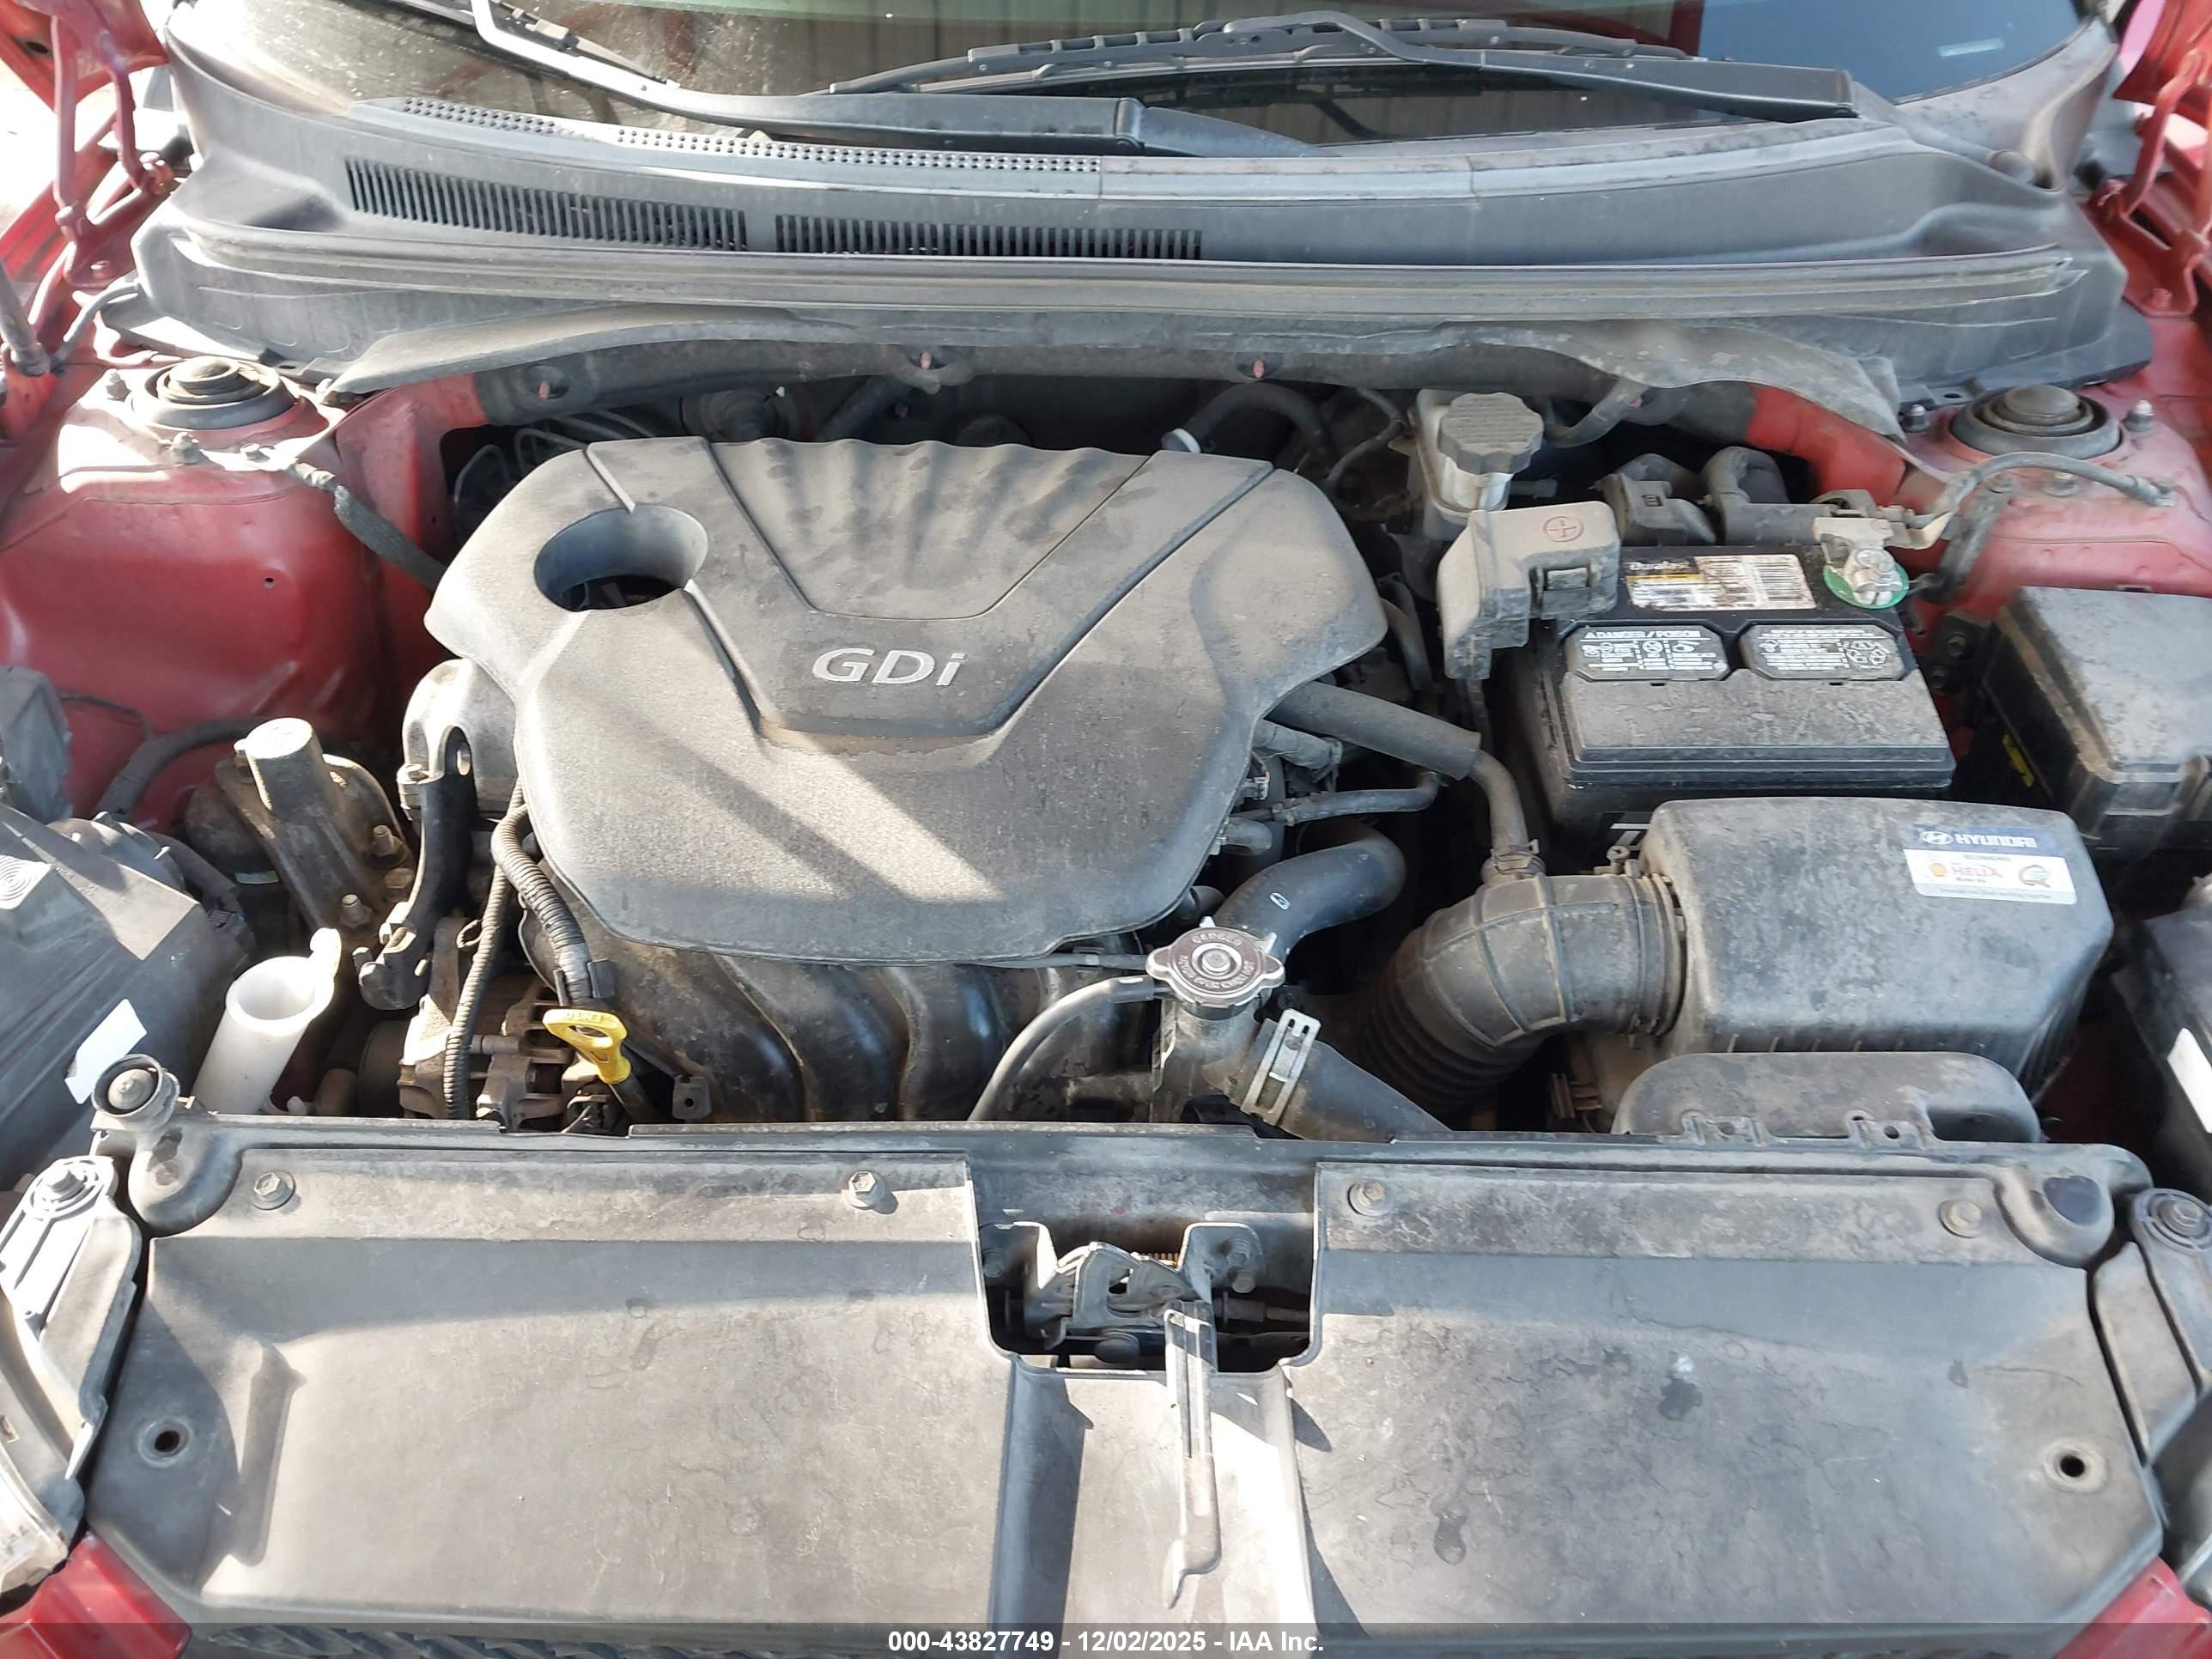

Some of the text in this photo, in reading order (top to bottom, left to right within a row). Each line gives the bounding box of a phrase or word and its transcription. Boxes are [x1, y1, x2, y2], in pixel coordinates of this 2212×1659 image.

[811, 647, 967, 687] GDi
[1954, 834, 2038, 848] HYUNDAI
[1951, 865, 2004, 878] HELIX
